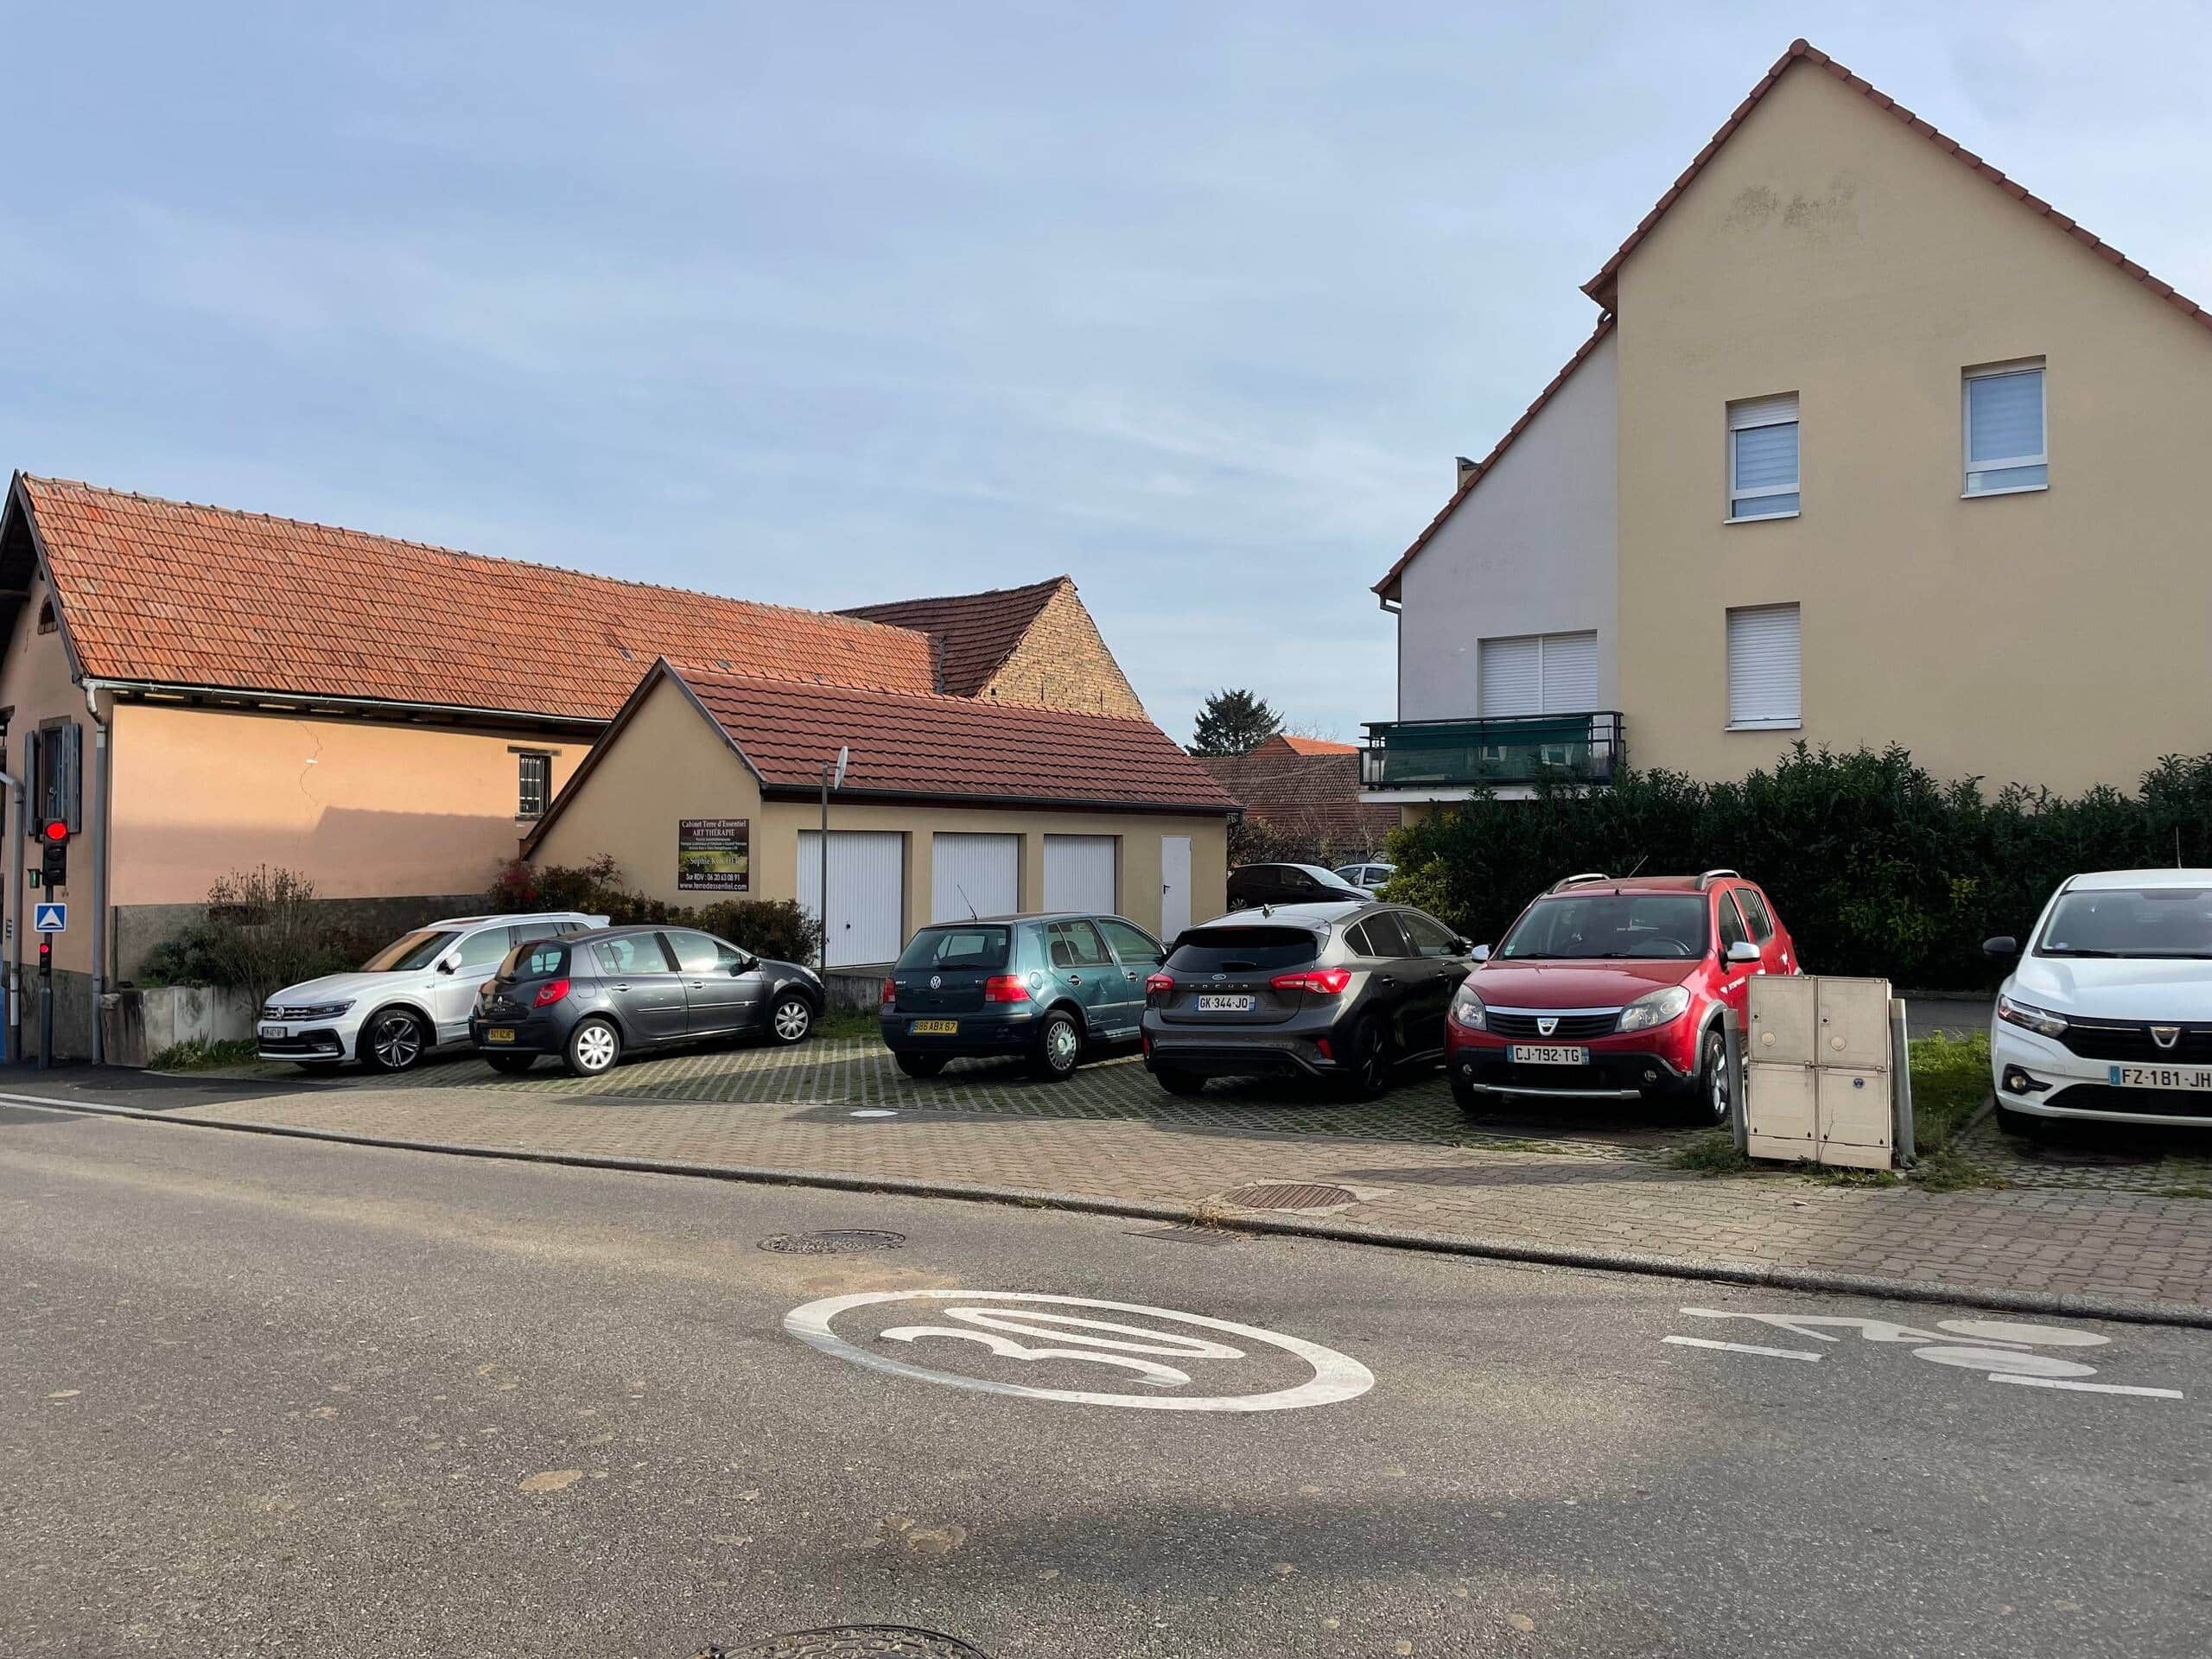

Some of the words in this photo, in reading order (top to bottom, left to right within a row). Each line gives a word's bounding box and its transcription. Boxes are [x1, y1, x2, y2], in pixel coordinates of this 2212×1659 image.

[690, 856, 711, 867] Sophie
[945, 1022, 956, 1032] 67
[1516, 1047, 1580, 1062] CJ-792-TG
